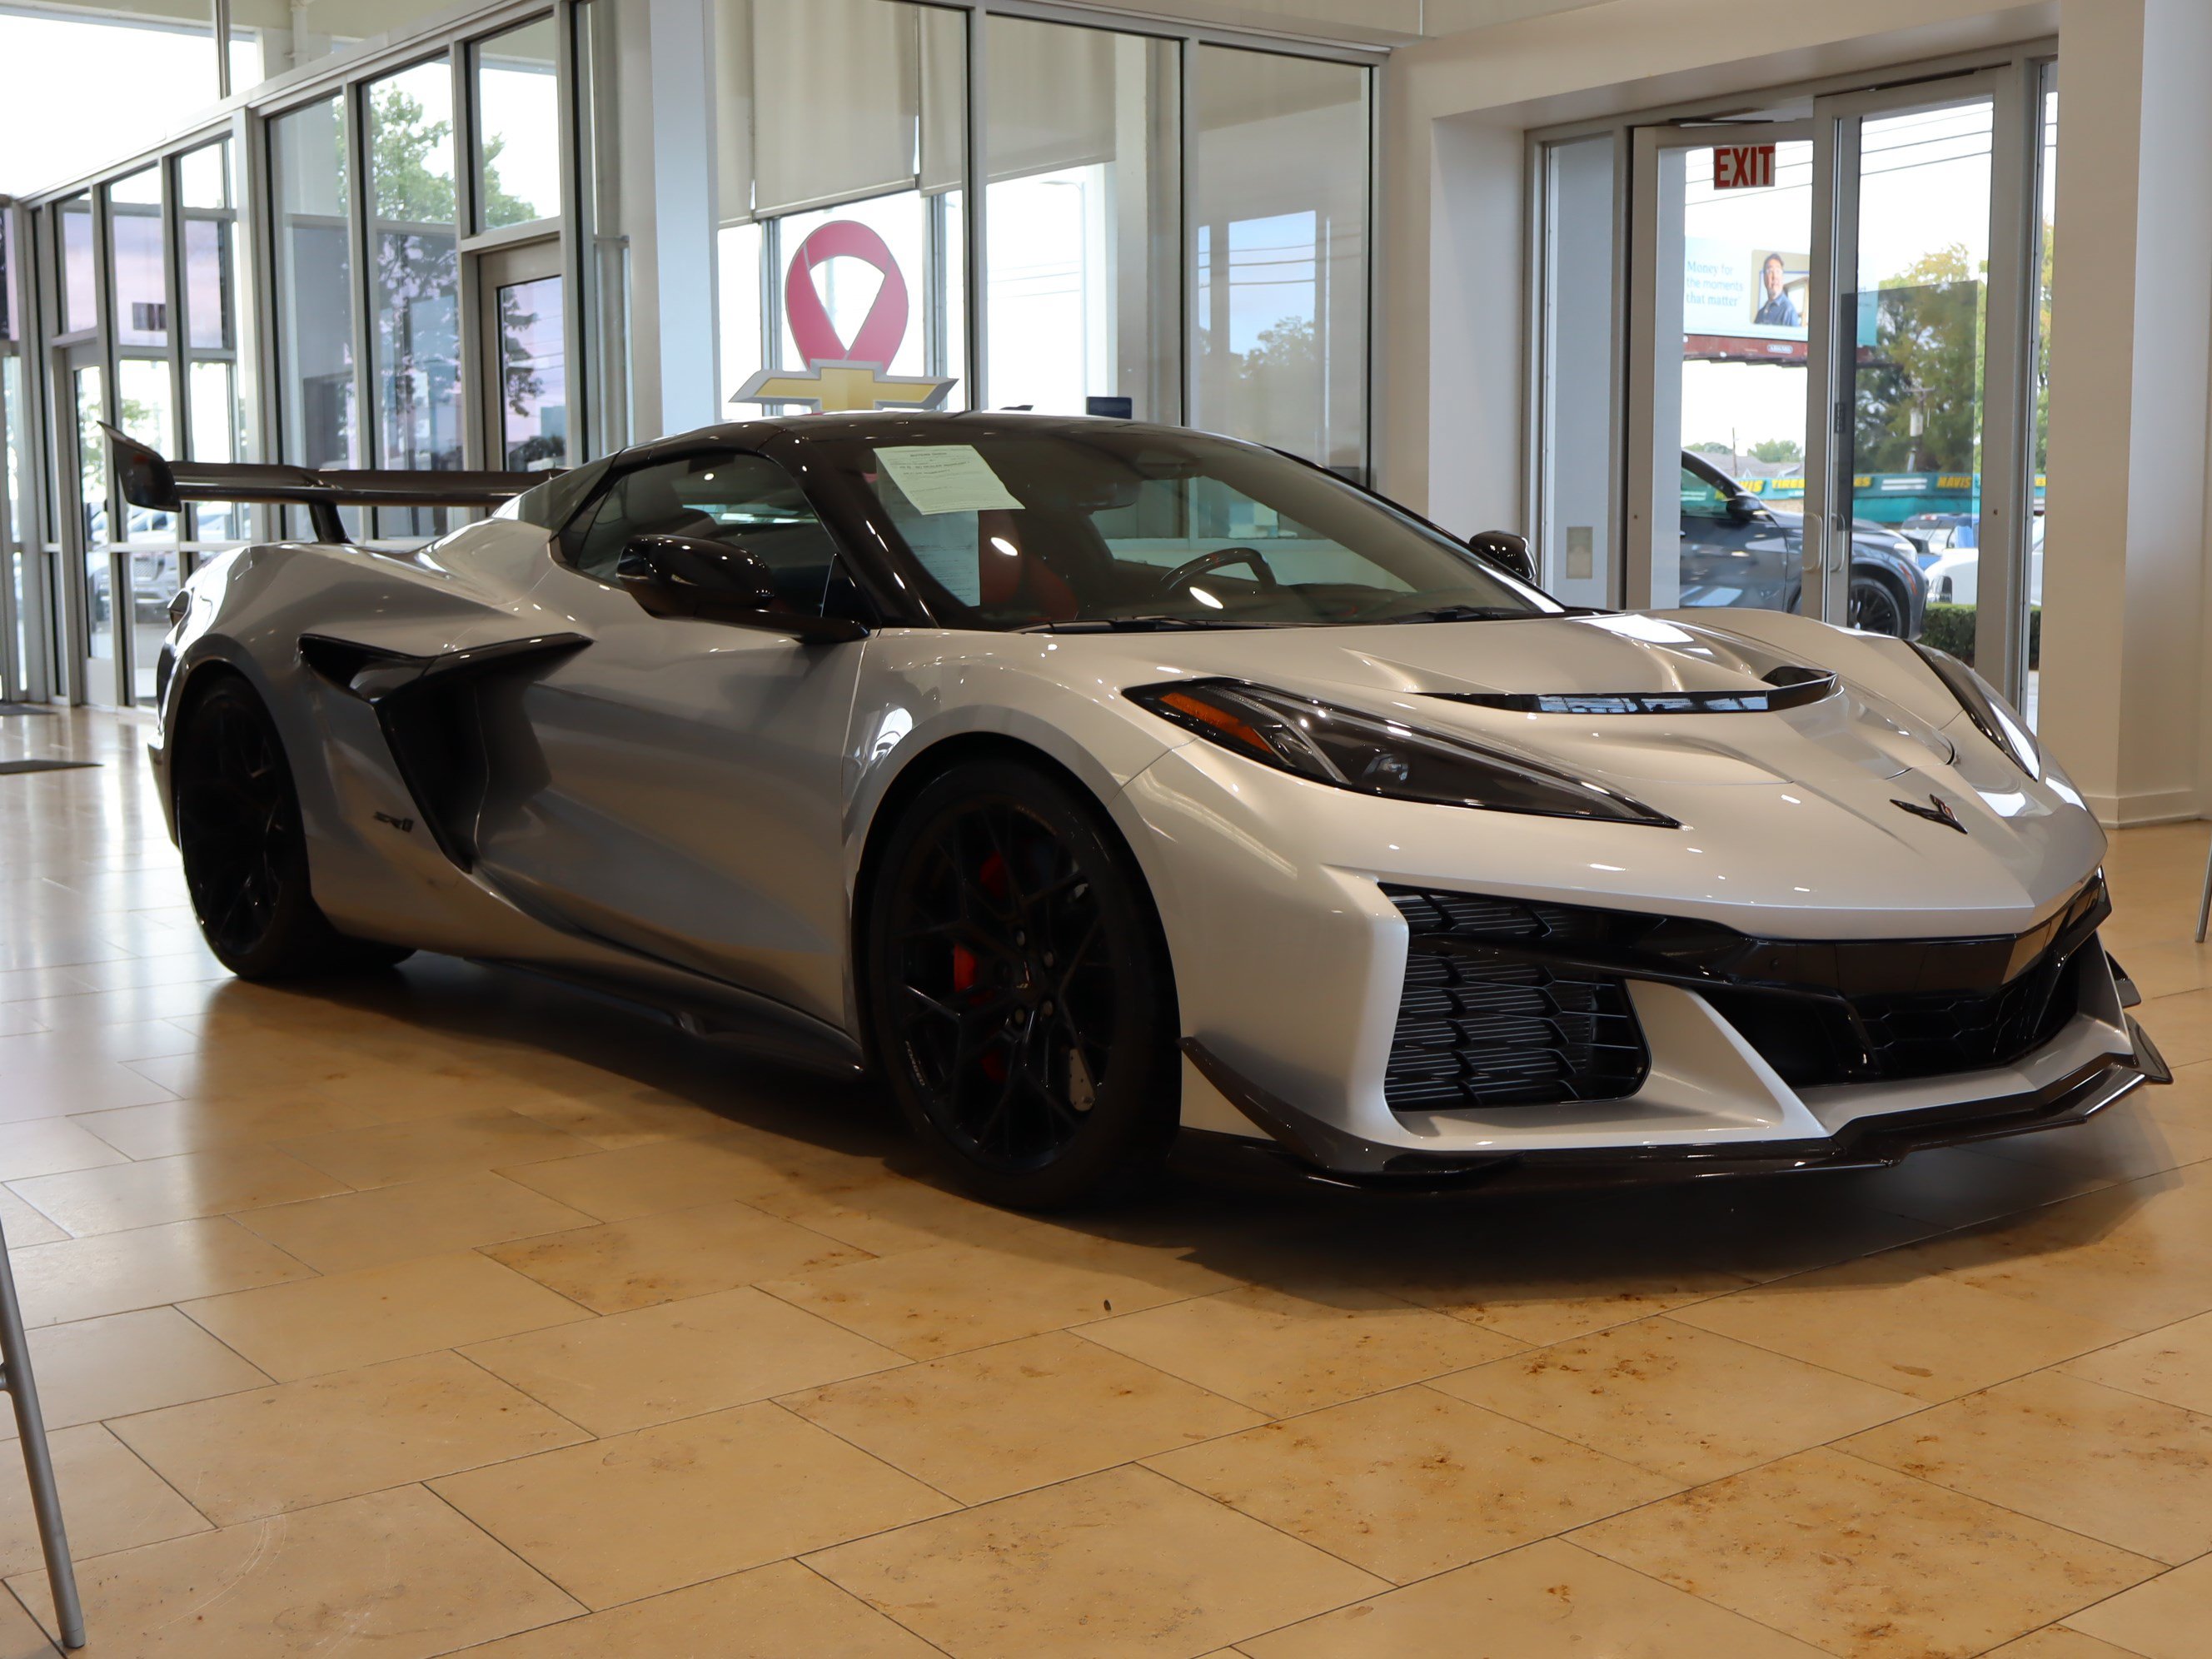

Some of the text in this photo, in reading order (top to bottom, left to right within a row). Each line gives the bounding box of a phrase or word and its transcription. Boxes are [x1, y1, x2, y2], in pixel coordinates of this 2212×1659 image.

[1715, 146, 1775, 187] EXIT
[1687, 261, 1734, 276] Money for
[1686, 277, 1744, 291] the moments
[1686, 291, 1705, 304] that
[1936, 476, 1972, 488] MAVIS
